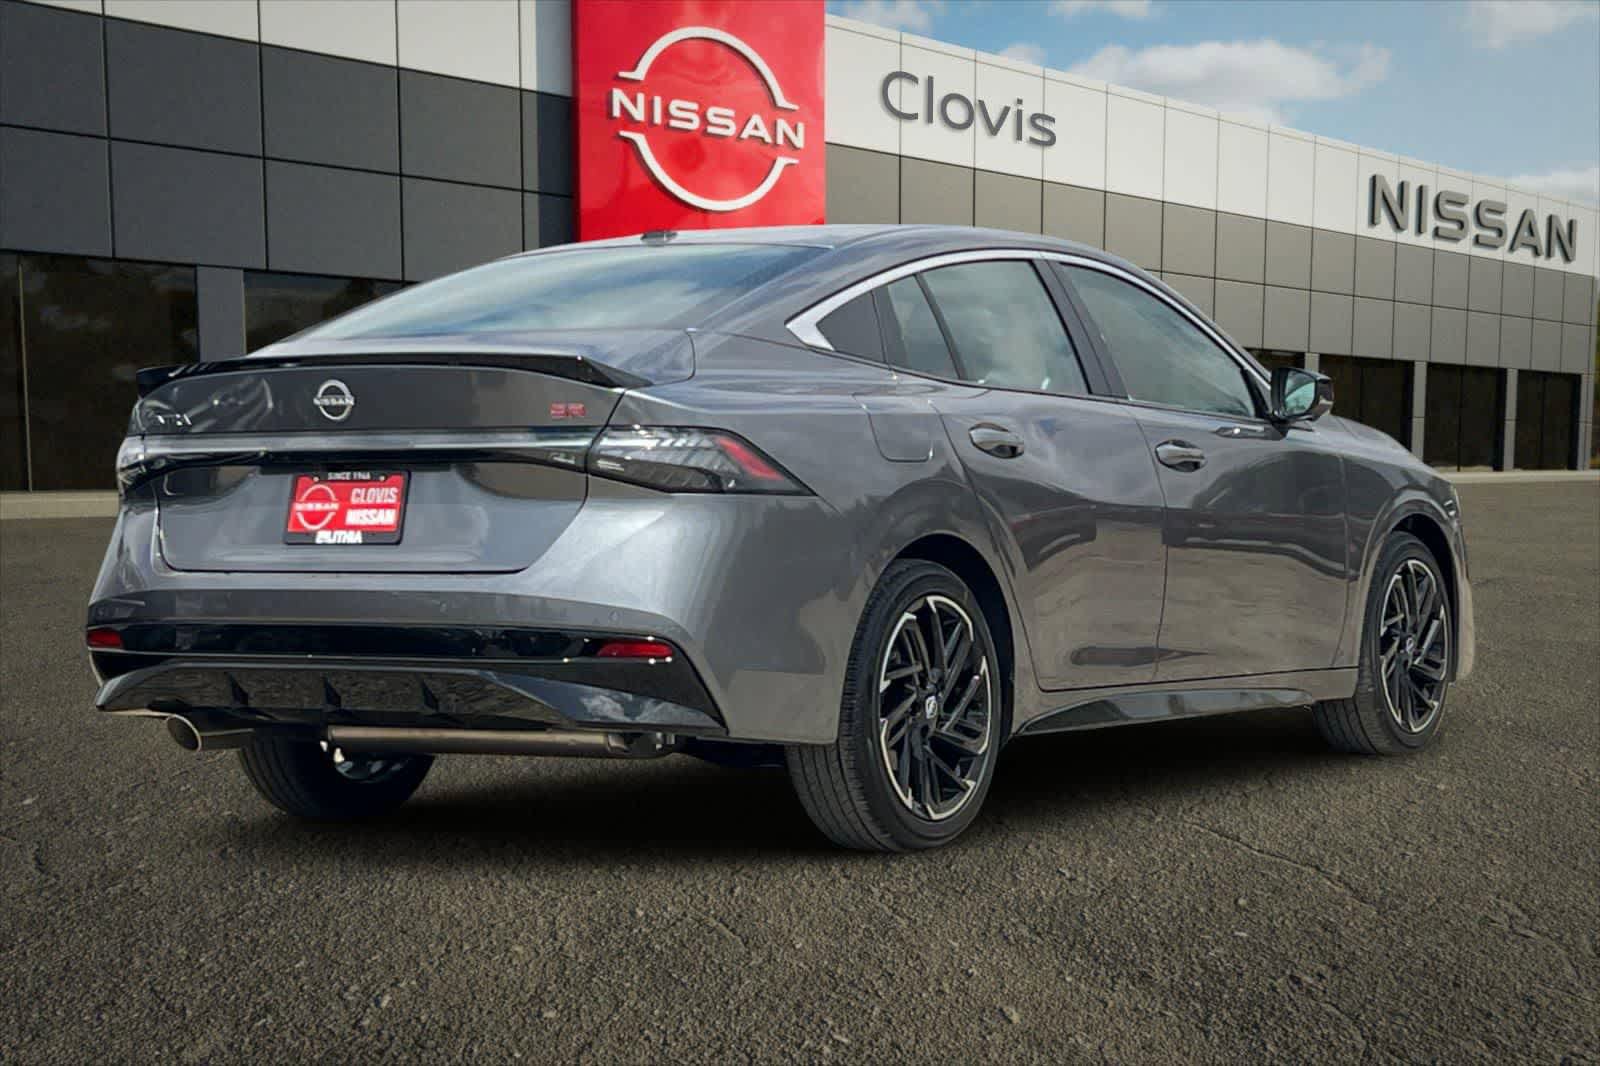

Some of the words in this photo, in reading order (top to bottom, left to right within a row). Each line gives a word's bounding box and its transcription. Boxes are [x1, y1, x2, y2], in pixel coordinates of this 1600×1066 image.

[611, 87, 804, 149] NISSAN
[881, 71, 1056, 147] Clovis
[1369, 174, 1577, 263] NISSAN
[294, 502, 339, 511] NISSAN
[350, 487, 398, 504] CLOVIS
[345, 508, 396, 525] NISSAN
